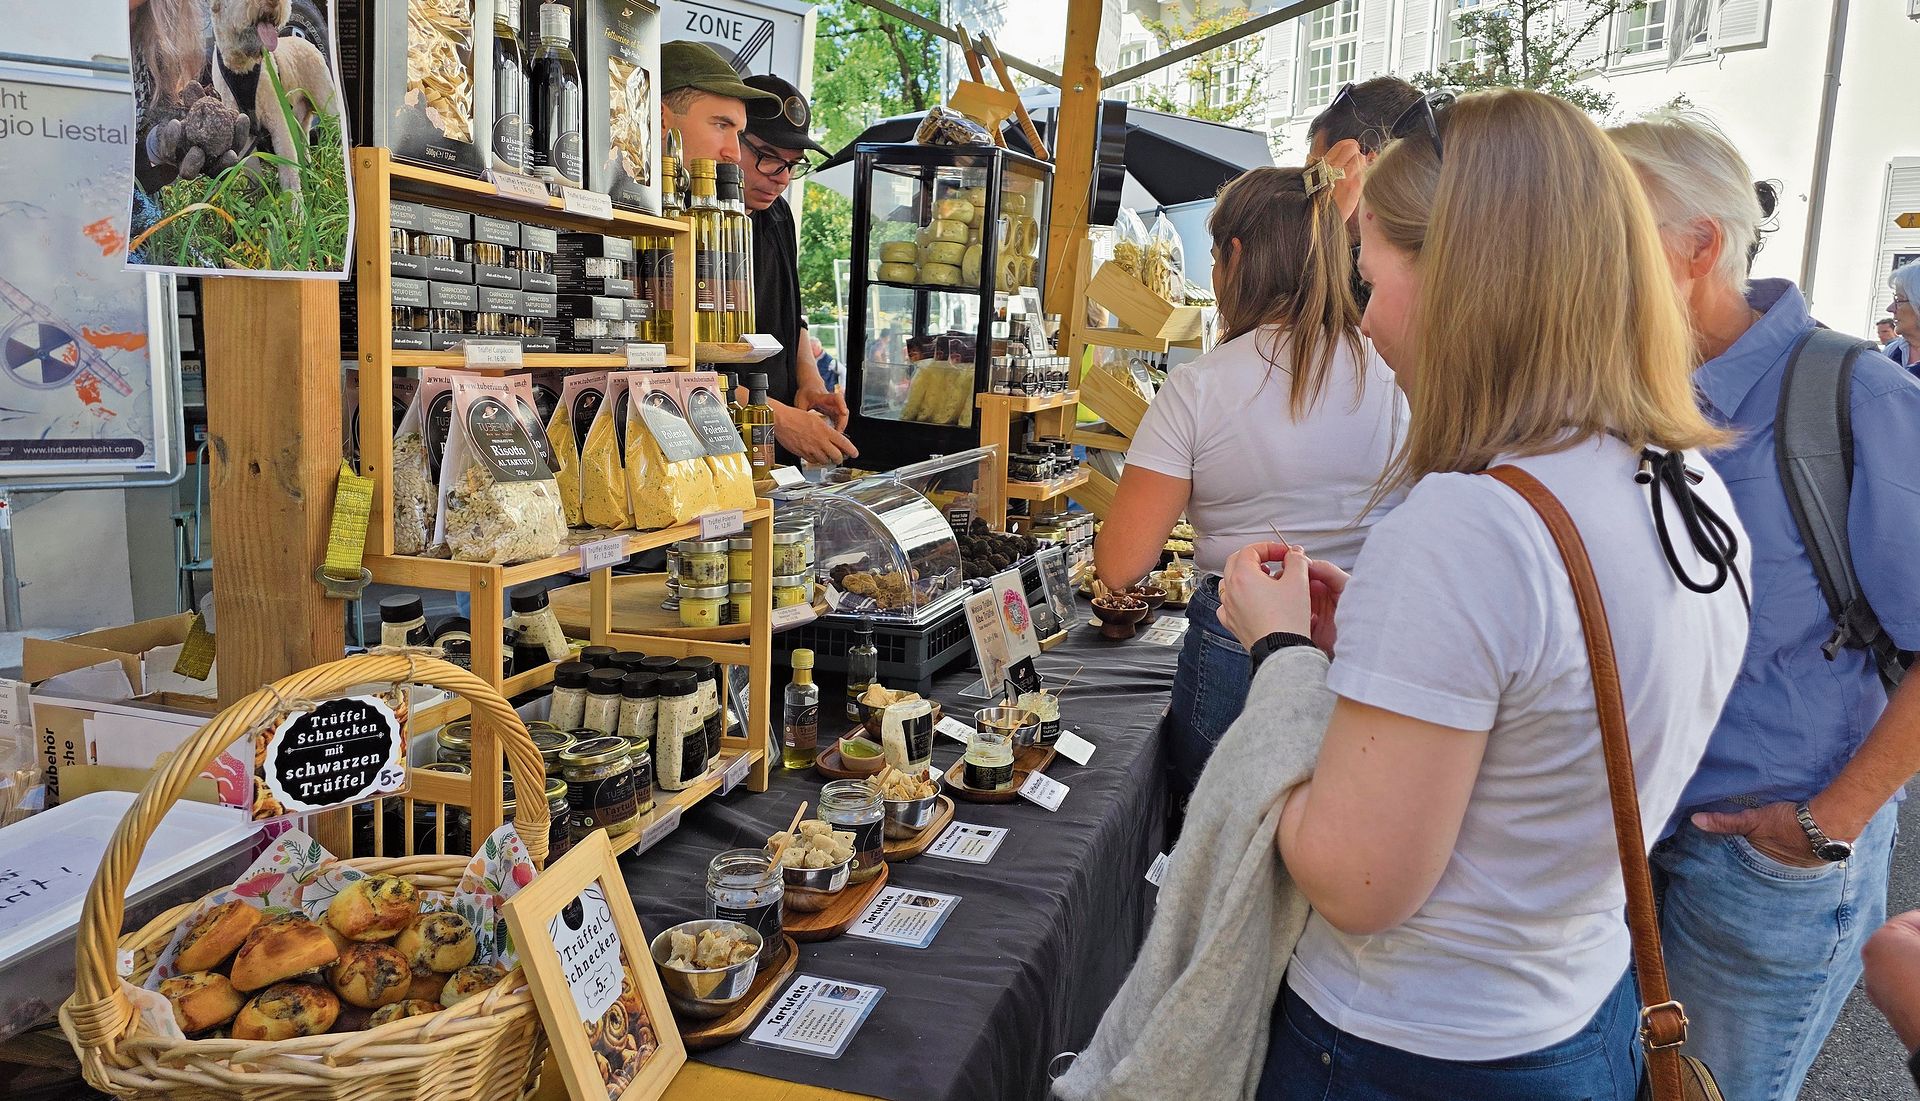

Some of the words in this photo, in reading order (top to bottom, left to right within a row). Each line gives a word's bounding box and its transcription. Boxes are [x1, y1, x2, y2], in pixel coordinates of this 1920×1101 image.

[685, 10, 743, 42] ZONE
[42, 116, 128, 145] Liestal
[661, 429, 687, 440] Polenta
[703, 425, 729, 435] Polenta
[23, 445, 134, 454] www.industrienacht.com
[490, 445, 526, 456] Risotto
[507, 458, 534, 466] TARTUFO
[588, 544, 603, 554] Trüffel
[604, 543, 619, 551] Risotto
[601, 551, 614, 559] 12.90
[310, 708, 367, 728] Trüffel
[297, 723, 378, 744] Schnecken
[325, 744, 344, 756] mit
[44, 728, 59, 796] Zubehör
[285, 753, 380, 780] schwarzen
[300, 771, 365, 797] Trüffel
[380, 769, 403, 786] 5.-
[862, 895, 894, 925] Tartufata
[563, 916, 603, 962] Trüffel
[595, 976, 608, 994] 5.-
[768, 985, 809, 1025] Tartufata
